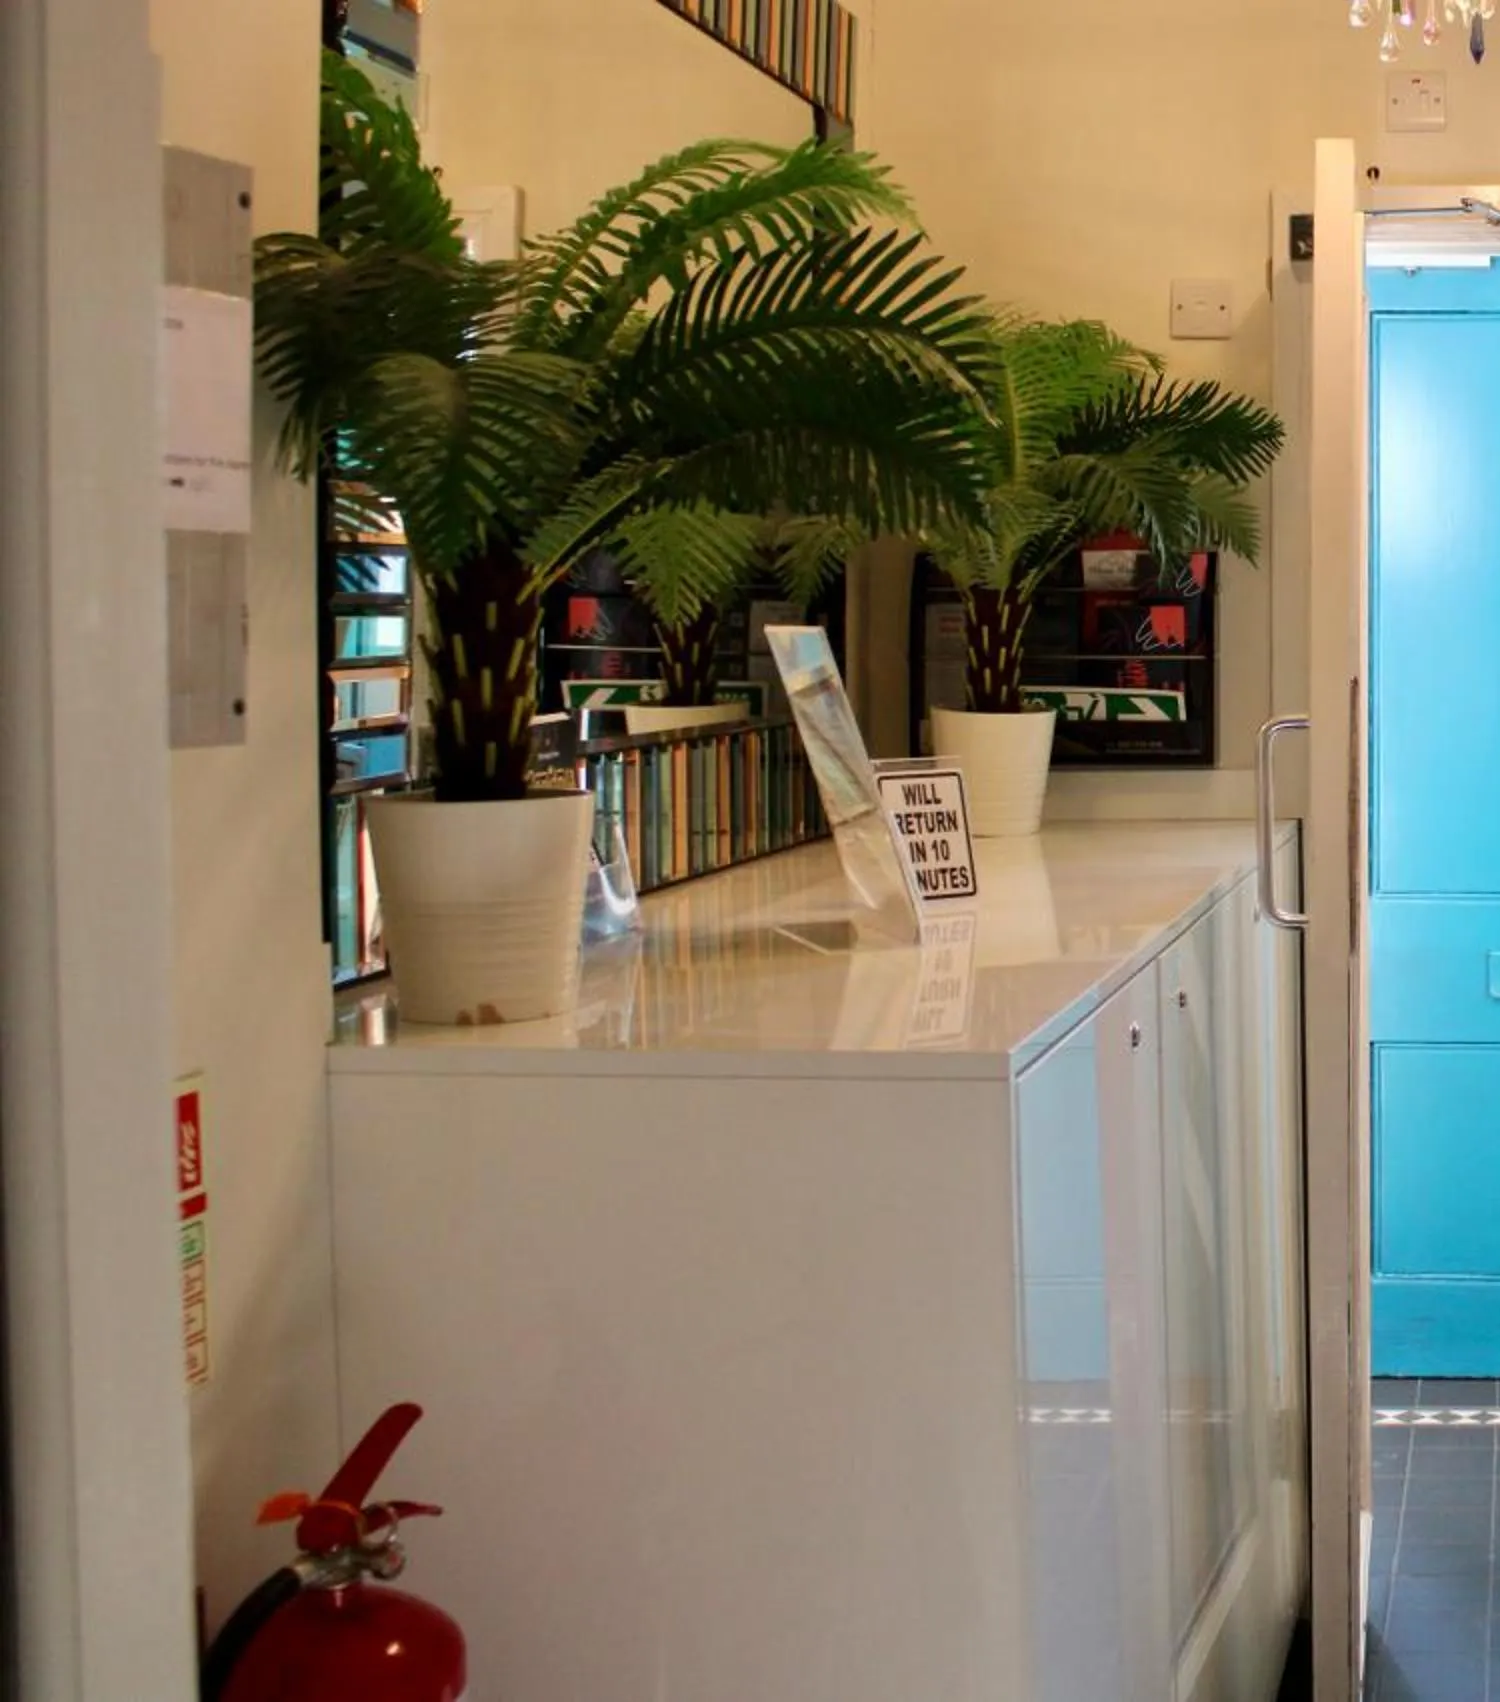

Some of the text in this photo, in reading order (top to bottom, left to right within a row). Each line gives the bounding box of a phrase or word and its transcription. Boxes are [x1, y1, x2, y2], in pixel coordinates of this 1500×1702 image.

[901, 783, 943, 806] WILL
[894, 810, 959, 834] RETURN
[909, 839, 950, 864] IN 10
[915, 865, 969, 891] NUTES
